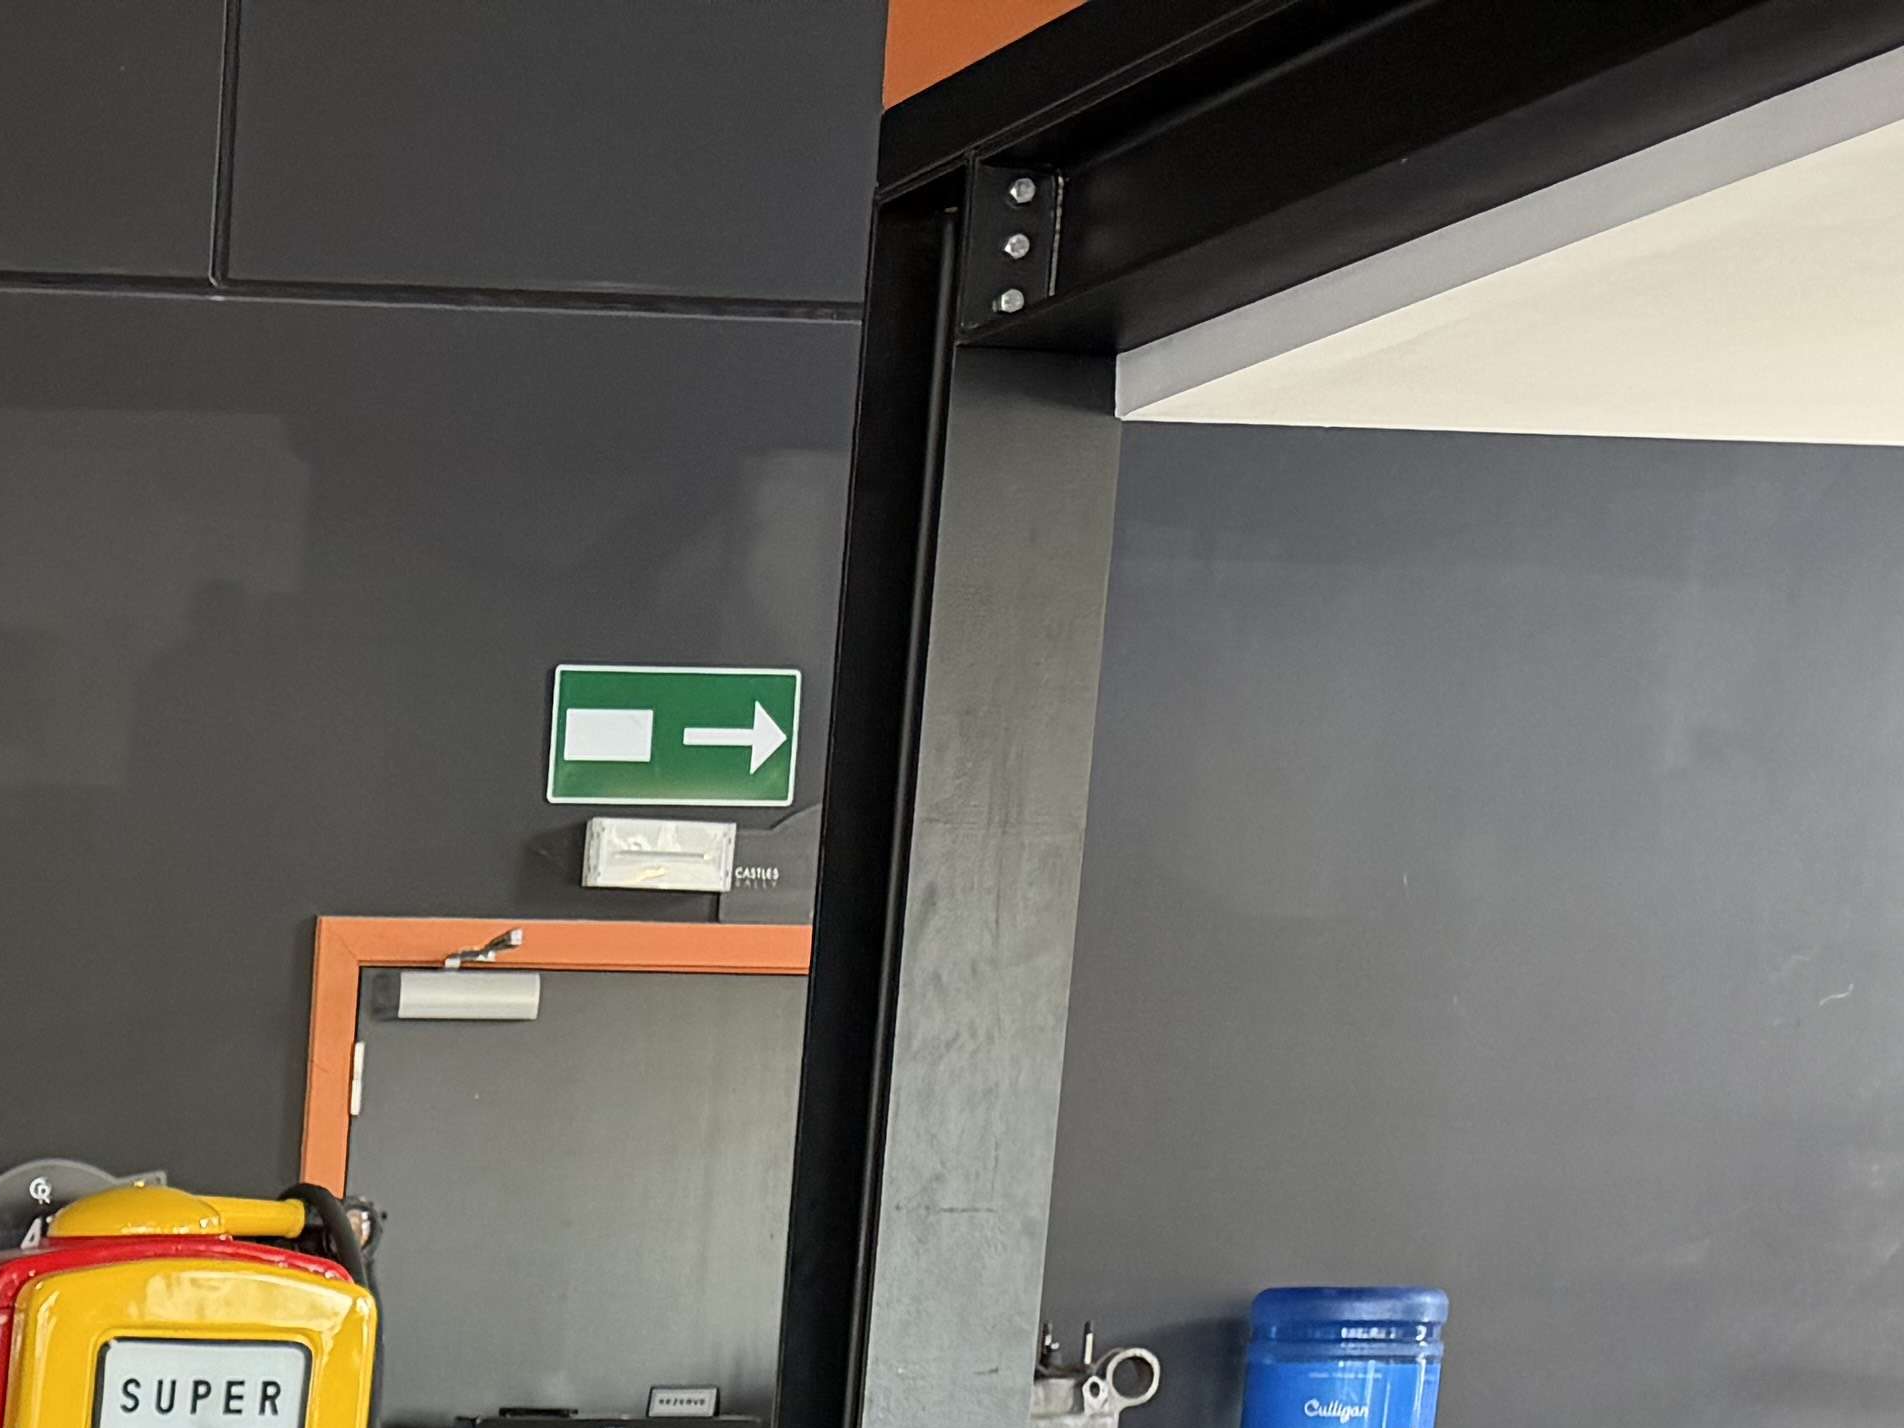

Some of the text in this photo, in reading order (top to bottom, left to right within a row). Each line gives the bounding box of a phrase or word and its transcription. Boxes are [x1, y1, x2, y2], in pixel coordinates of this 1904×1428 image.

[735, 866, 779, 880] CASTLES
[120, 1378, 281, 1415] SUPER
[1304, 1400, 1370, 1423] Culligan
